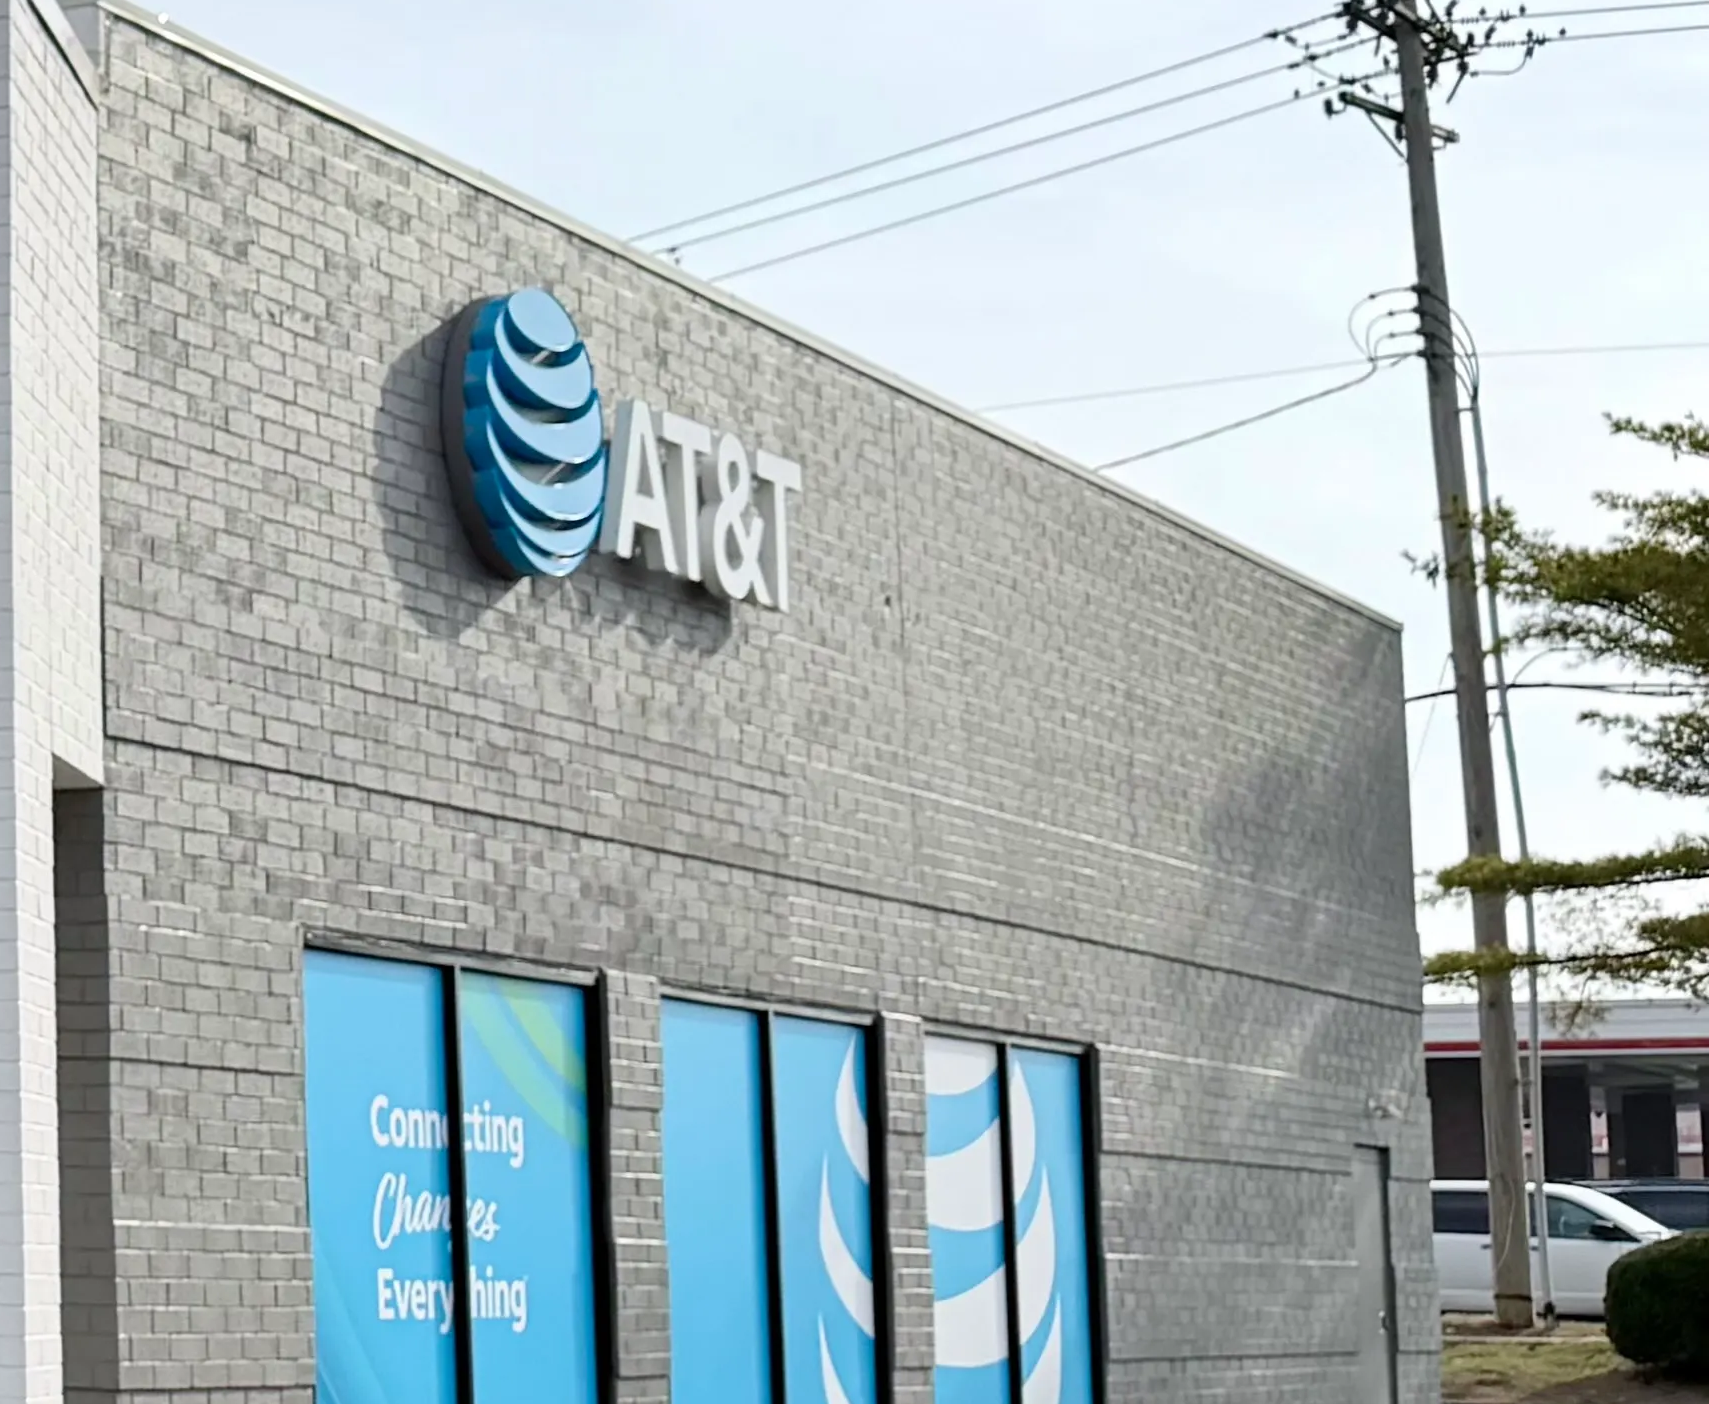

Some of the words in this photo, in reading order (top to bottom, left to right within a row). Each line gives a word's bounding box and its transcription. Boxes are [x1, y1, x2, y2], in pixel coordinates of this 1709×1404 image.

[601, 399, 803, 614] AT&T
[373, 1171, 501, 1251] Chanes
[377, 1264, 527, 1335] Everyhing
